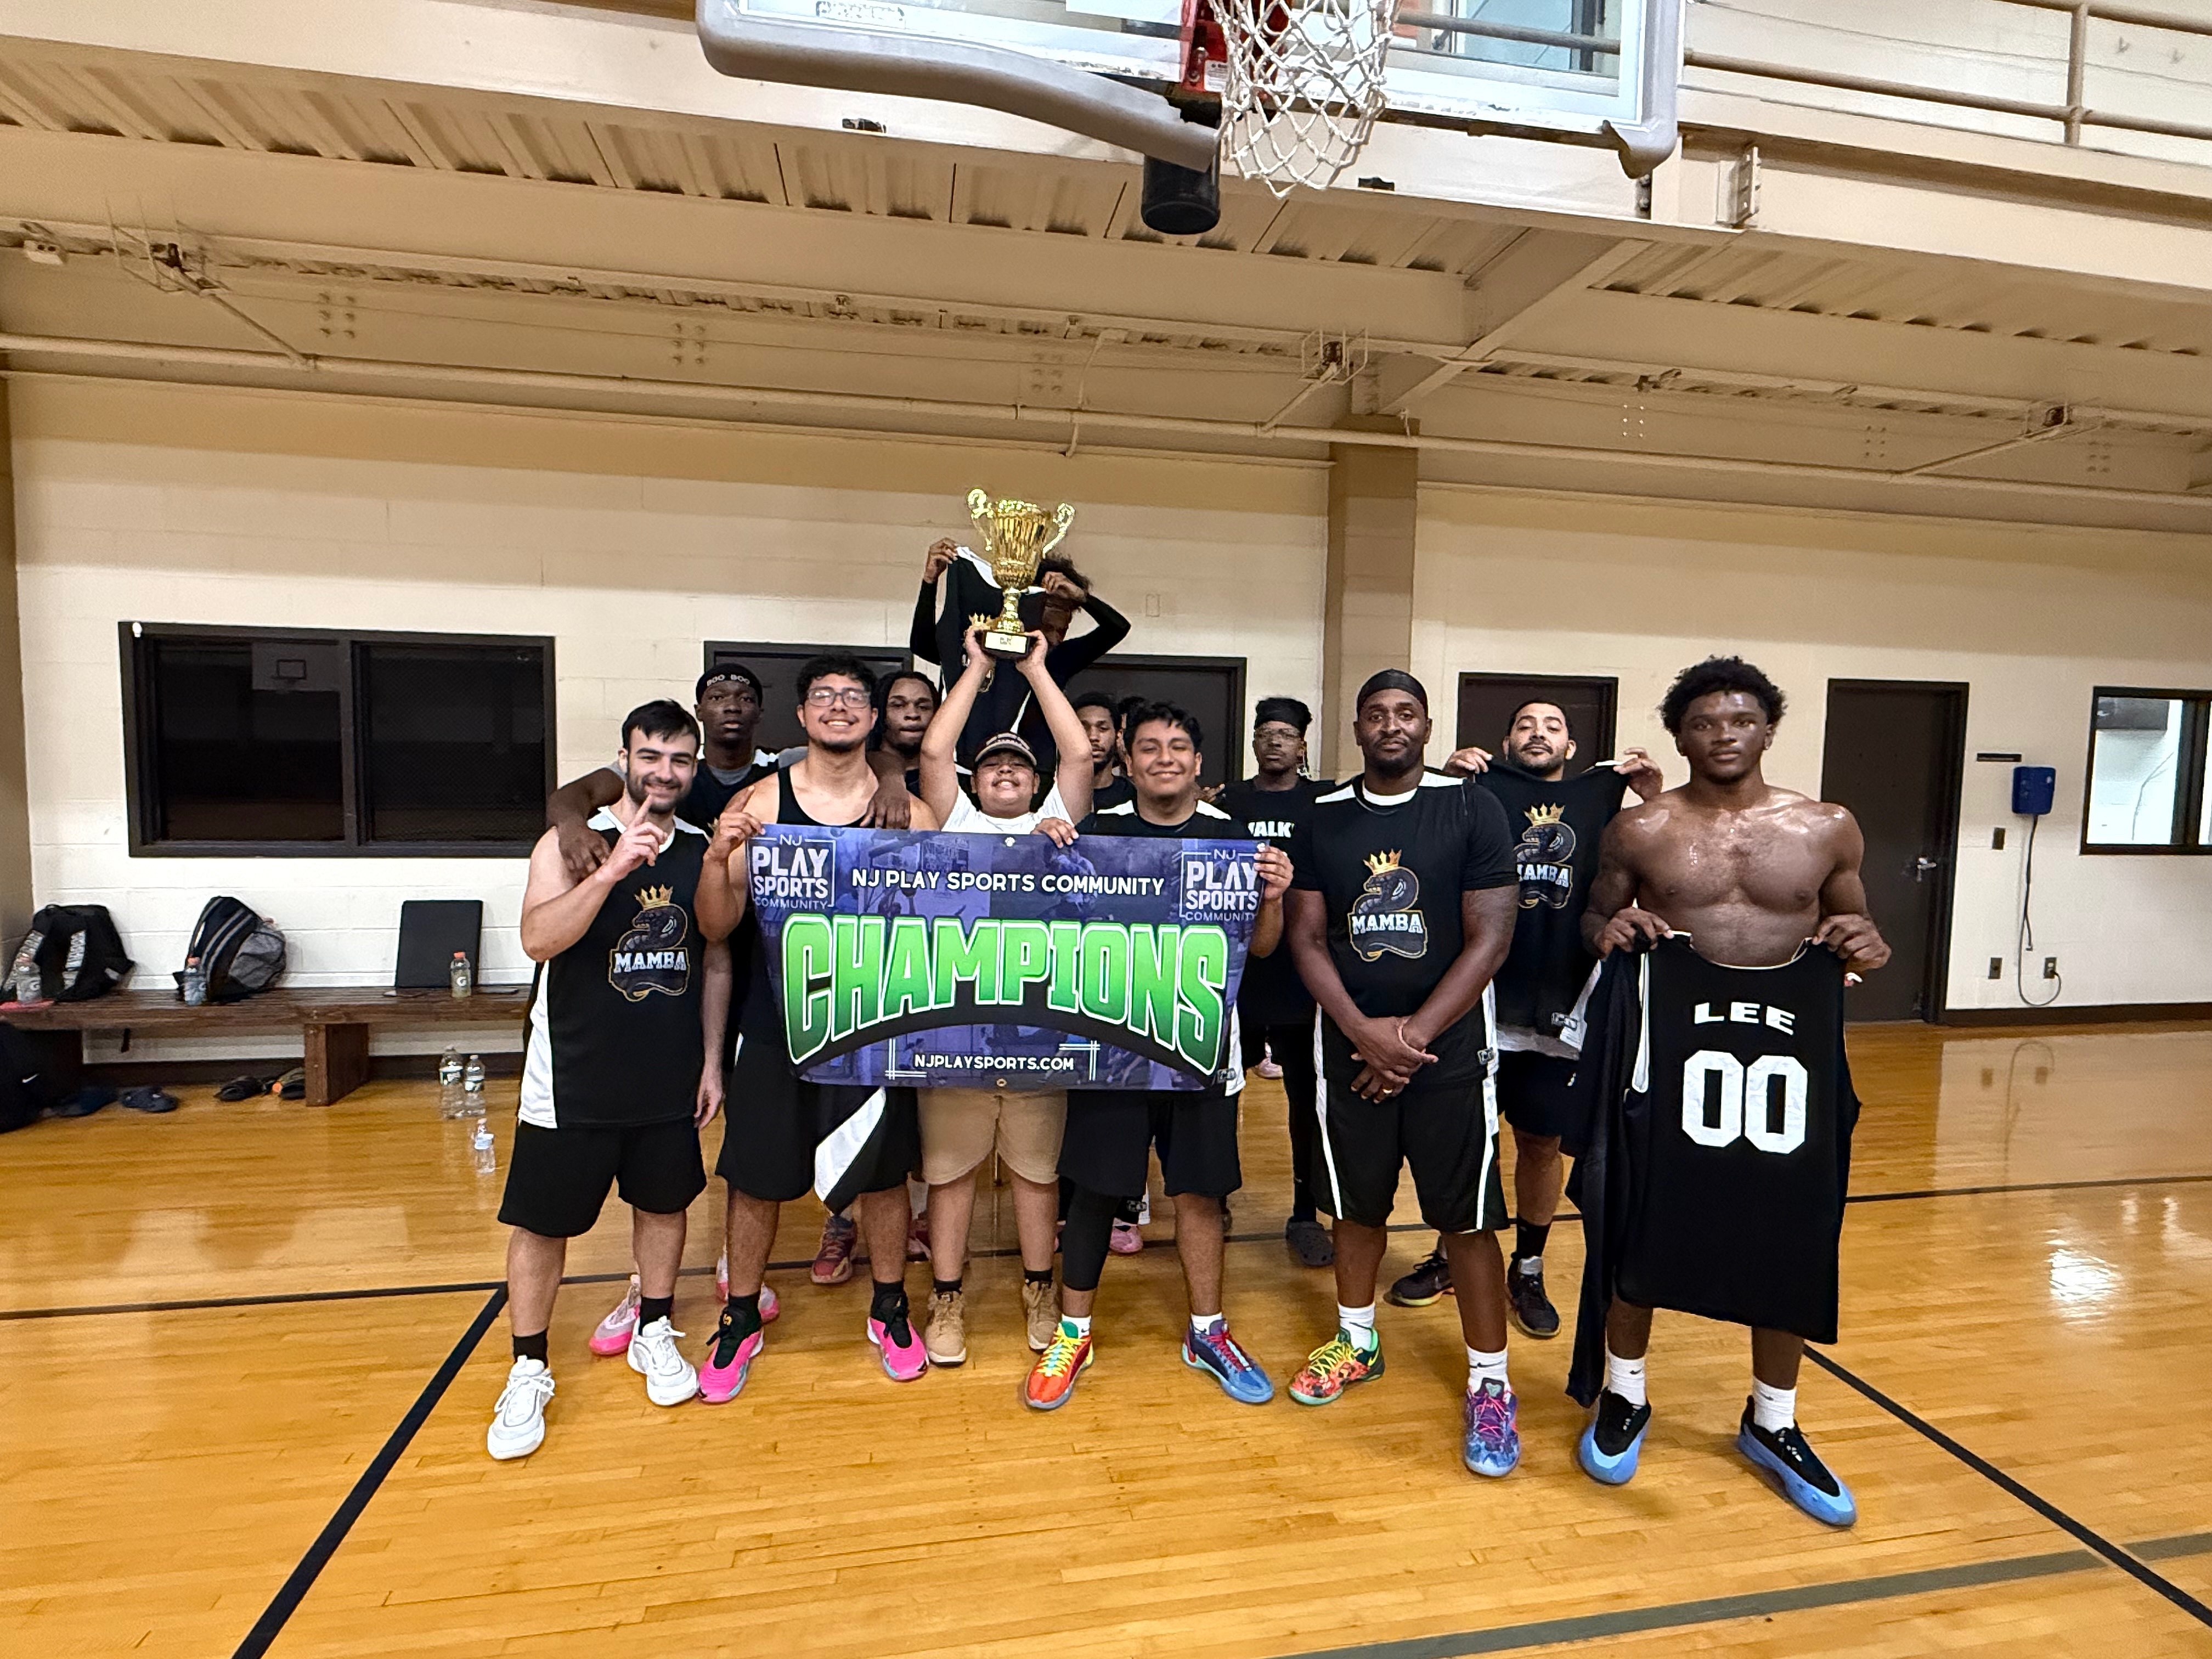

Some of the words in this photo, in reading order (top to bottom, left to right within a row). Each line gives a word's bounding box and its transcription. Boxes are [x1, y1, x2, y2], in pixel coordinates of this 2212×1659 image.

[779, 834, 803, 846] NJ
[752, 846, 830, 878] PLAY
[1214, 849, 1236, 860] NJ
[852, 869, 878, 887] NJ
[886, 870, 939, 889] PLAY
[947, 872, 1035, 892] SPORTS
[1041, 874, 1164, 896] COMMUNITY
[1186, 861, 1258, 890] PLAY
[754, 876, 828, 899] SPORTS
[755, 896, 828, 910] COMMUNITY
[1186, 890, 1259, 911] SPORTS
[1352, 914, 1423, 935] MAMBA
[613, 951, 686, 973] MAMBA
[457, 977, 466, 986] G
[783, 915, 1228, 1076] CHAMPIONS
[1694, 1002, 1795, 1035] LEE
[915, 1054, 1074, 1070] NJPLAYSPORTS.COM
[1682, 1049, 1808, 1155] 00
